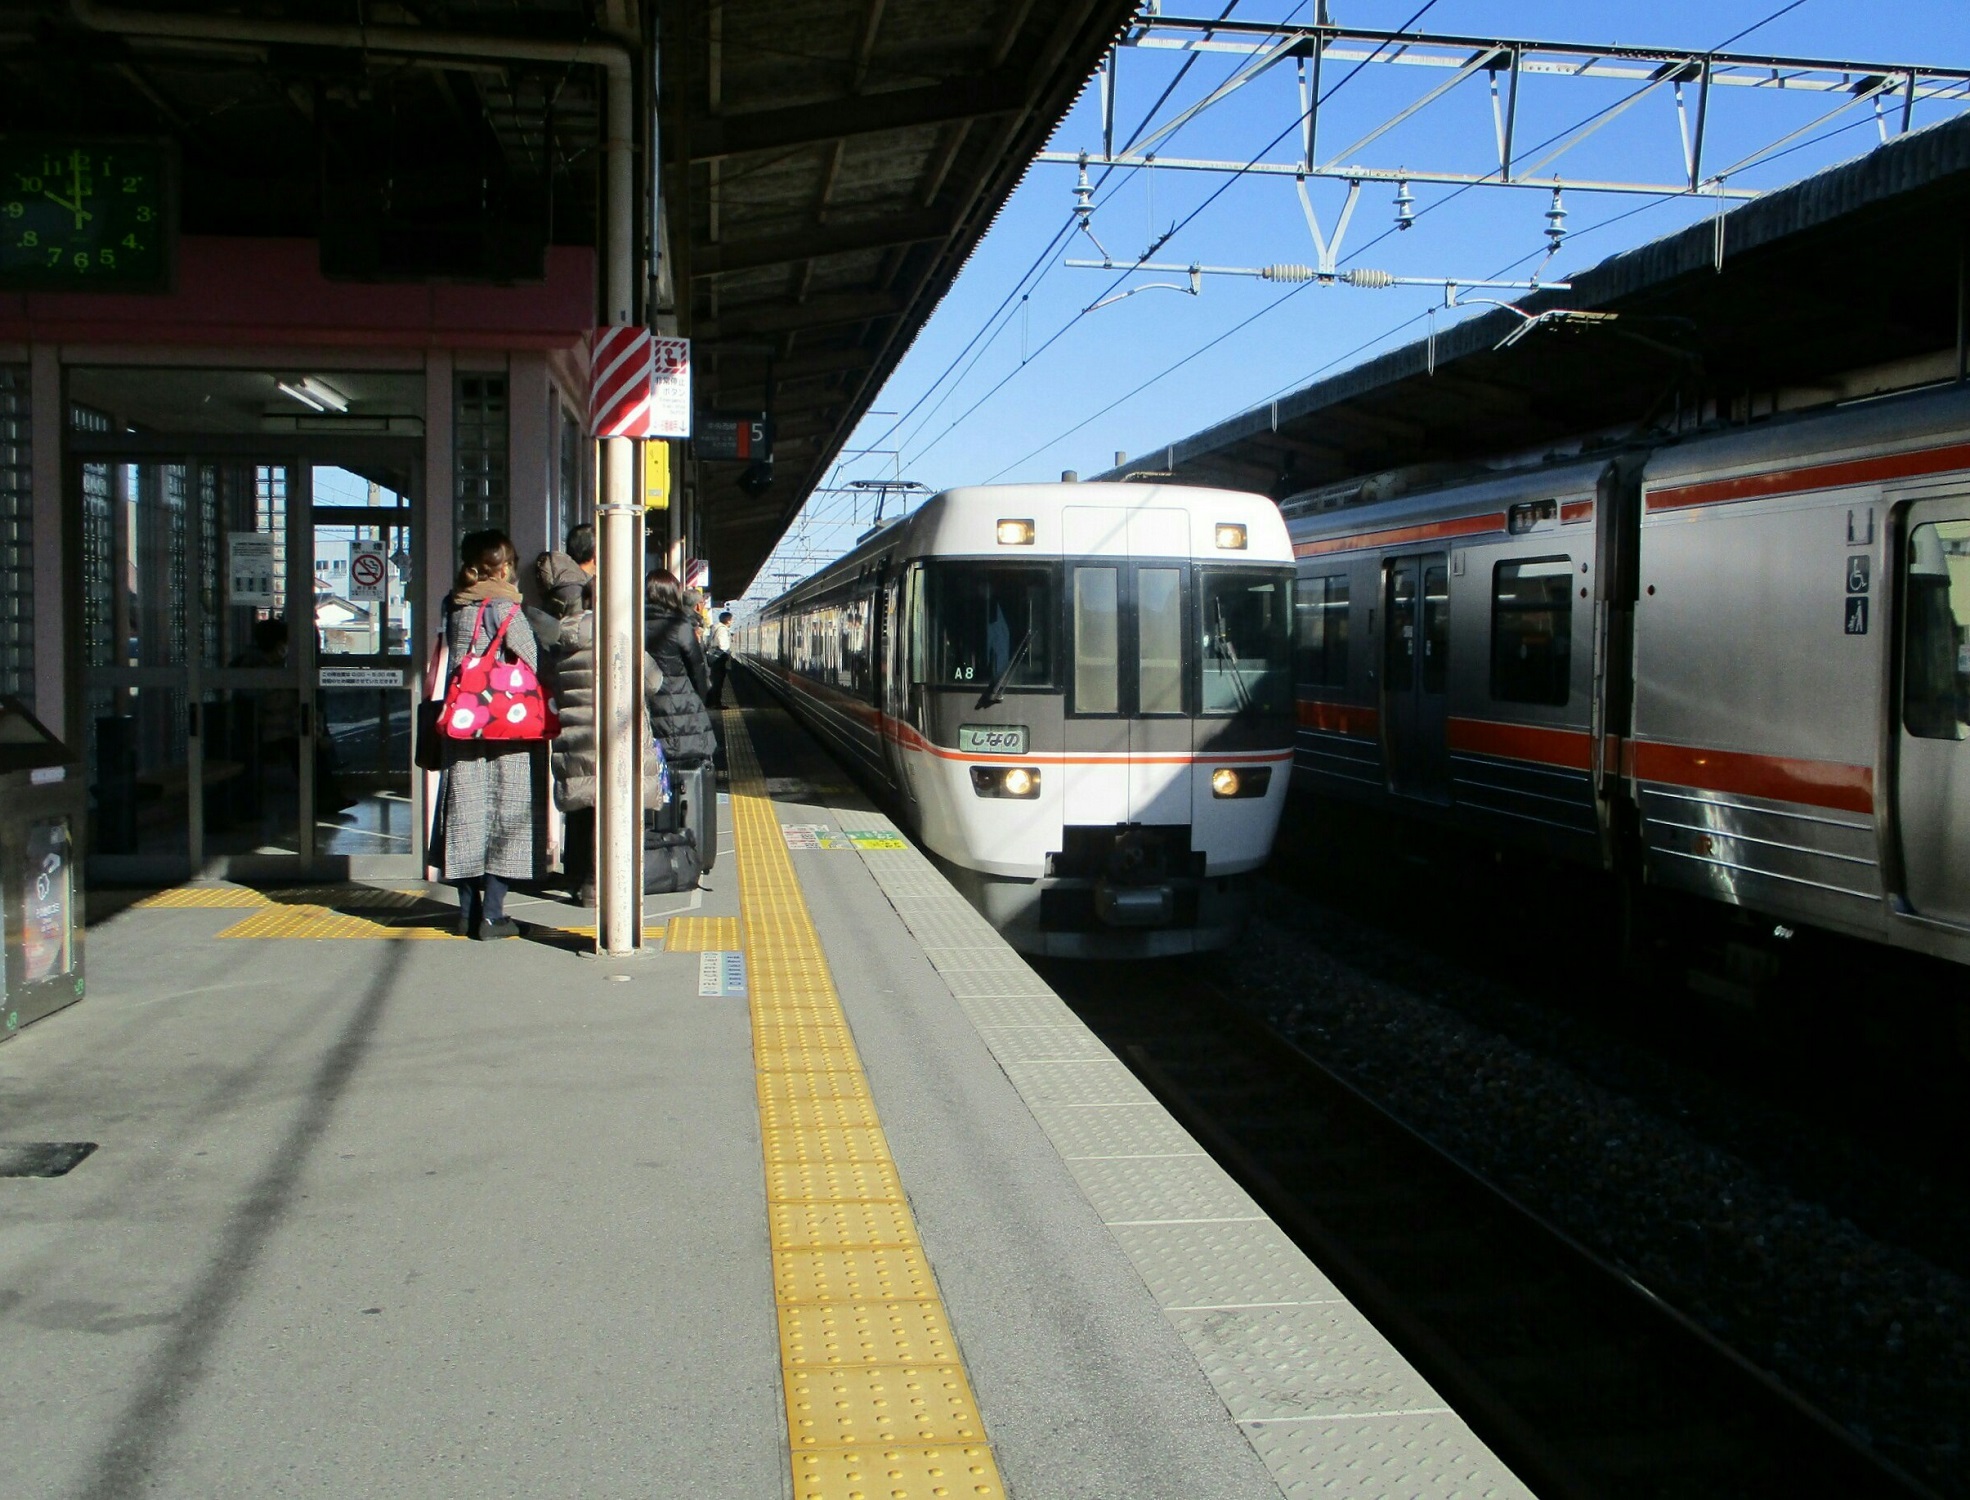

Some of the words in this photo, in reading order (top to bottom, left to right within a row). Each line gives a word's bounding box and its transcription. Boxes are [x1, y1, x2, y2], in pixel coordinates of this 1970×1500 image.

[43, 160, 62, 176] 11
[20, 176, 43, 192] 10
[121, 177, 138, 193] 2
[8, 202, 24, 219] 9
[136, 205, 152, 222] 3
[23, 229, 39, 247] 8
[121, 232, 138, 249] 4
[48, 247, 63, 265] 7
[73, 251, 90, 269] 6
[99, 248, 115, 265] 5
[751, 422, 764, 442] 5
[955, 667, 974, 679] A8
[971, 732, 1020, 747] しなの
